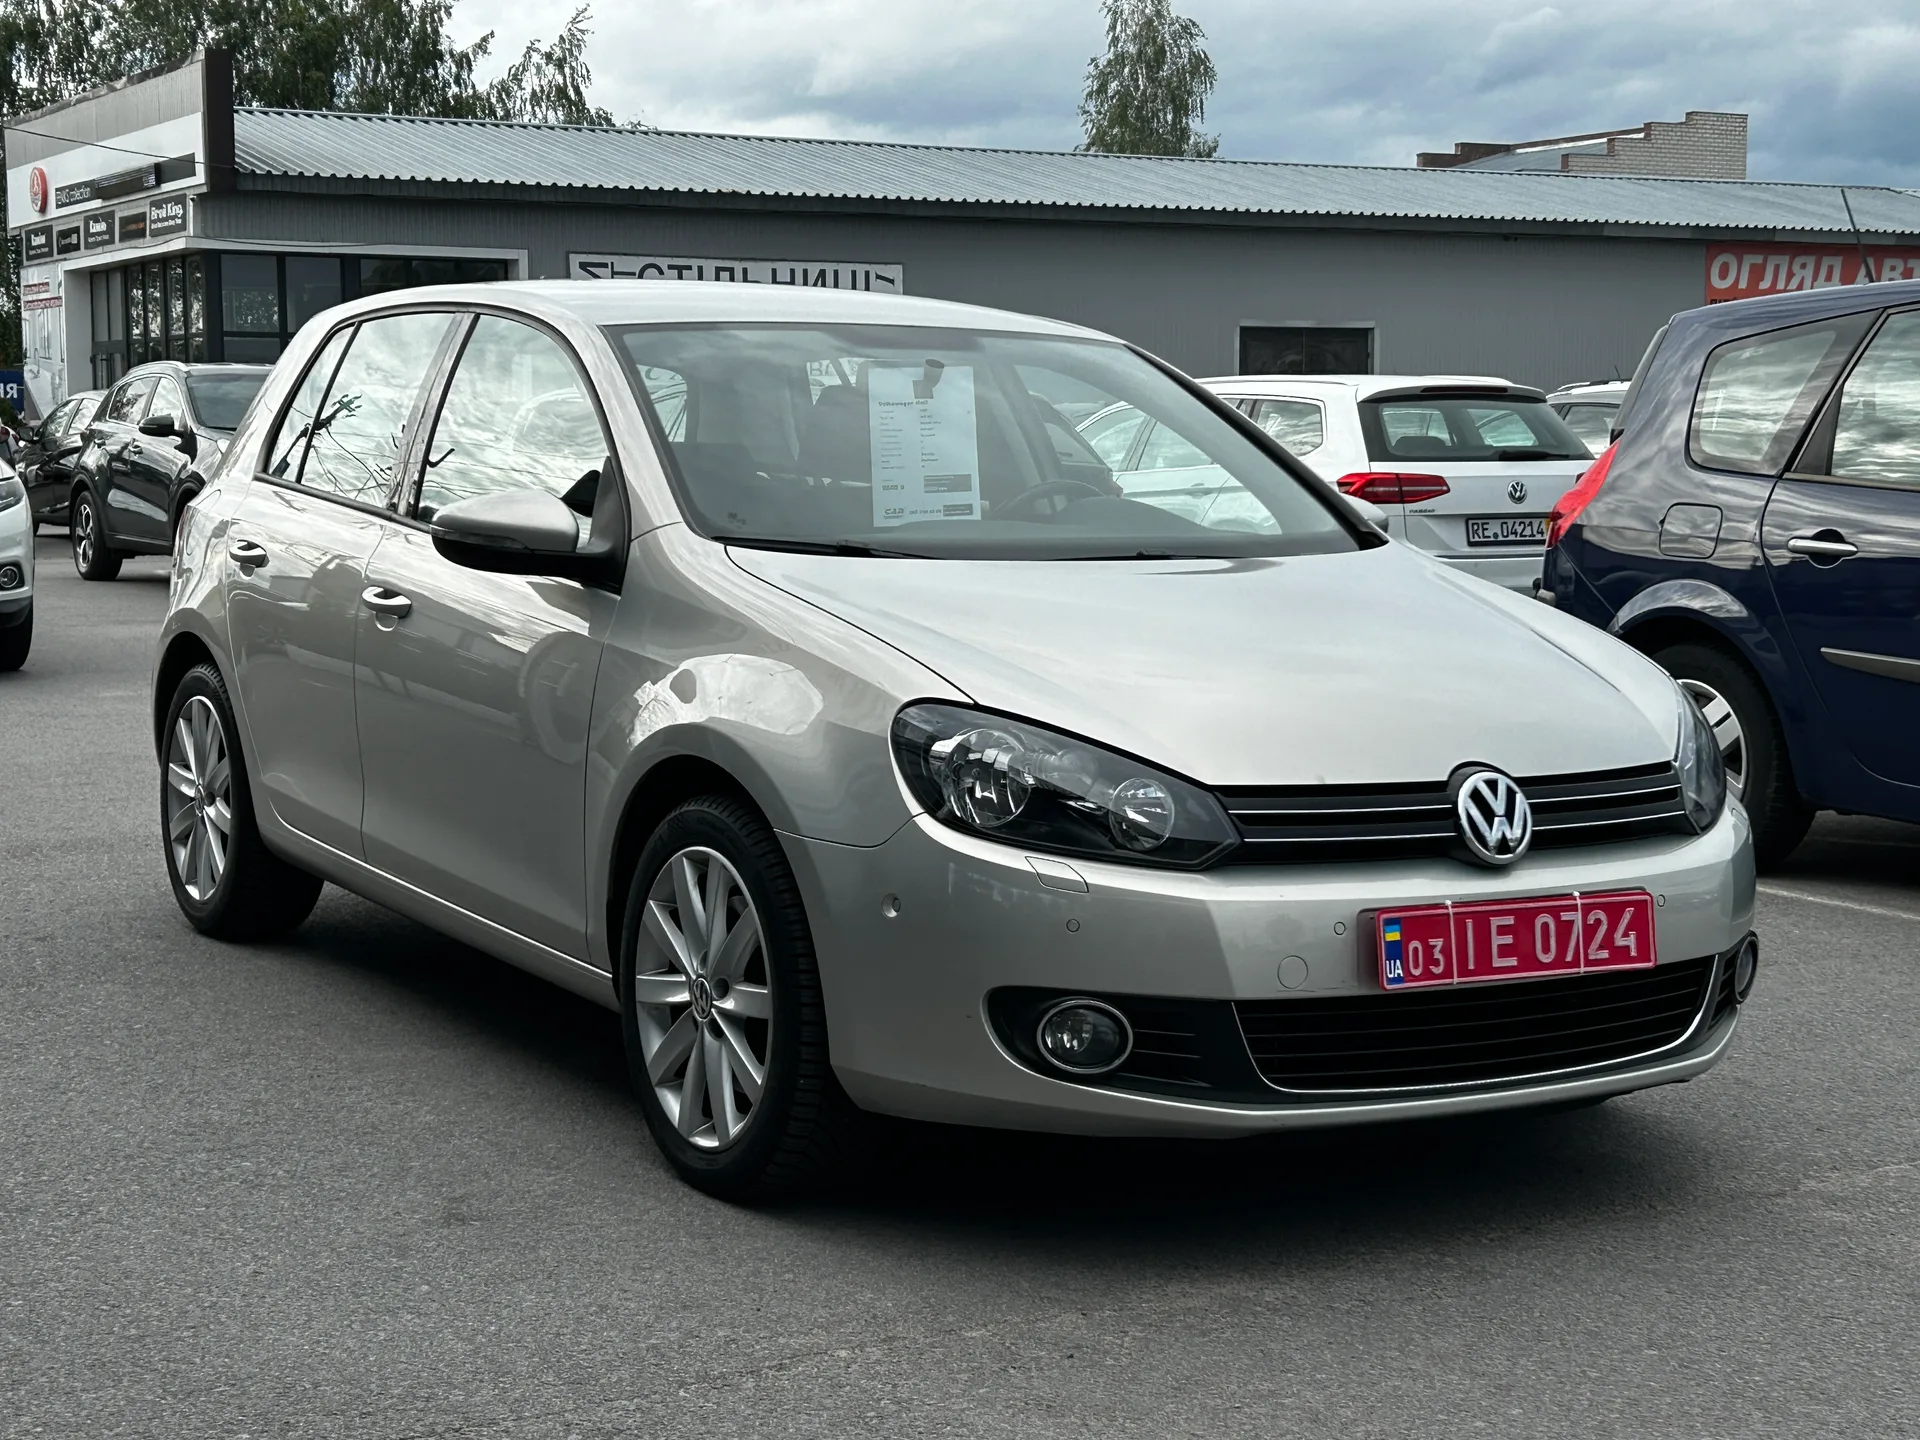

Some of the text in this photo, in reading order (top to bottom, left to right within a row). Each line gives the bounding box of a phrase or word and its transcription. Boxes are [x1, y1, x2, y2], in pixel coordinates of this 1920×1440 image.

[1710, 253, 1843, 290] ОГЛЯД
[1500, 521, 1545, 538] 04214
[1408, 907, 1639, 976] 03 IE 0724
[1386, 959, 1404, 978] UA
